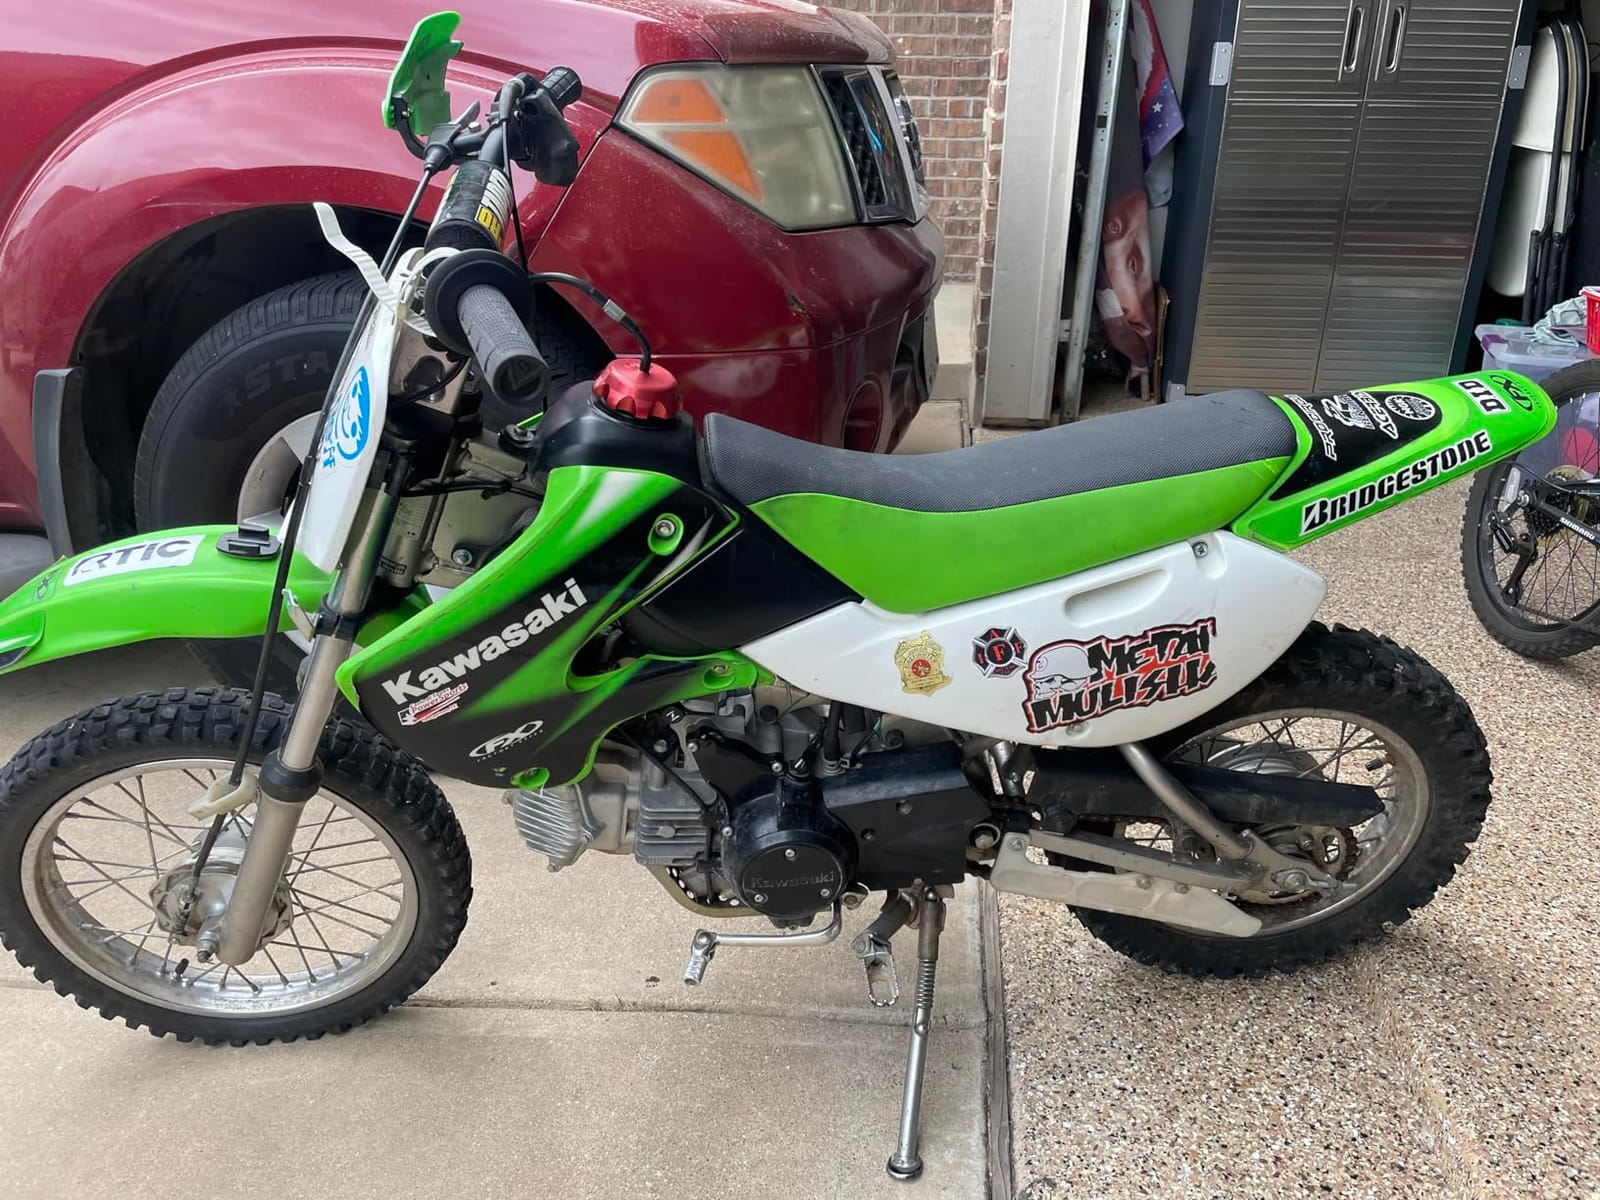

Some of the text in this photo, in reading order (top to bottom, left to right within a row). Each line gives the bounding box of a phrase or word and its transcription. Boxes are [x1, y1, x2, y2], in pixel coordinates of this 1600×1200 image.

[1302, 430, 1492, 535] BRIDGESTONE
[71, 539, 191, 577] RTIC
[1559, 517, 1596, 540] SHIMANO
[381, 577, 588, 705] Kawasaki
